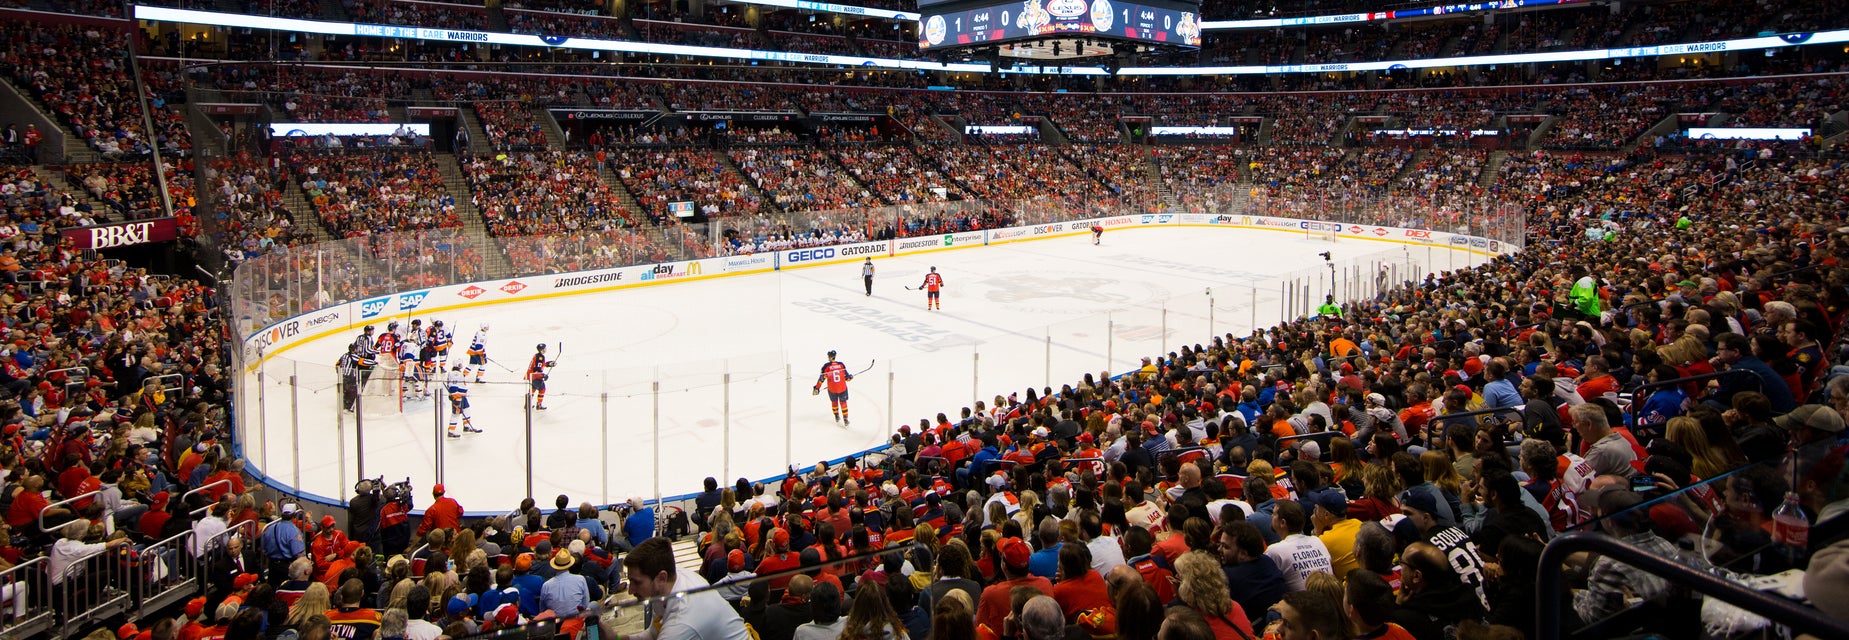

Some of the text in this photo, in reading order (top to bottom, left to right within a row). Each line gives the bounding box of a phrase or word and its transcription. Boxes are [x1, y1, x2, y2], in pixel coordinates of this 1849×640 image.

[973, 12, 989, 23] 4:44
[1001, 10, 1009, 26] 0
[1122, 9, 1128, 24] 1
[1140, 10, 1154, 20] 4:44
[955, 17, 961, 32] 1
[1164, 15, 1171, 30] 0
[357, 24, 488, 42] HOME OF THE CARE WARRIORS
[1610, 42, 1726, 57] HOME OF THE CARE WARRIORS
[804, 54, 829, 62] WARRIORS
[243, 106, 257, 114] 132
[1105, 217, 1132, 226] HONDA
[1217, 214, 1232, 223] day
[1034, 224, 1063, 235] DISCOVER
[1300, 221, 1341, 232] GEICO
[90, 221, 154, 250] BB&T
[1013, 230, 1026, 238] LIGHT
[1405, 229, 1432, 239] DEX
[899, 239, 939, 250] BRIDGESTONE
[945, 234, 982, 247] enterprise
[788, 248, 835, 263] GEICO
[841, 244, 886, 256] GATORADE
[641, 264, 674, 281] all day
[656, 271, 686, 279] BREAKFAST
[554, 271, 623, 288] BRIDGESTONE
[928, 277, 937, 286] 51
[461, 288, 482, 297] ORKIN
[503, 283, 524, 292] ORKIN
[400, 294, 424, 308] SAP
[362, 302, 385, 317] SAP
[255, 321, 300, 354] DISCOVER
[832, 369, 841, 383] 6
[1292, 549, 1324, 561] FLORIDA
[1292, 557, 1330, 572] PANTHERS
